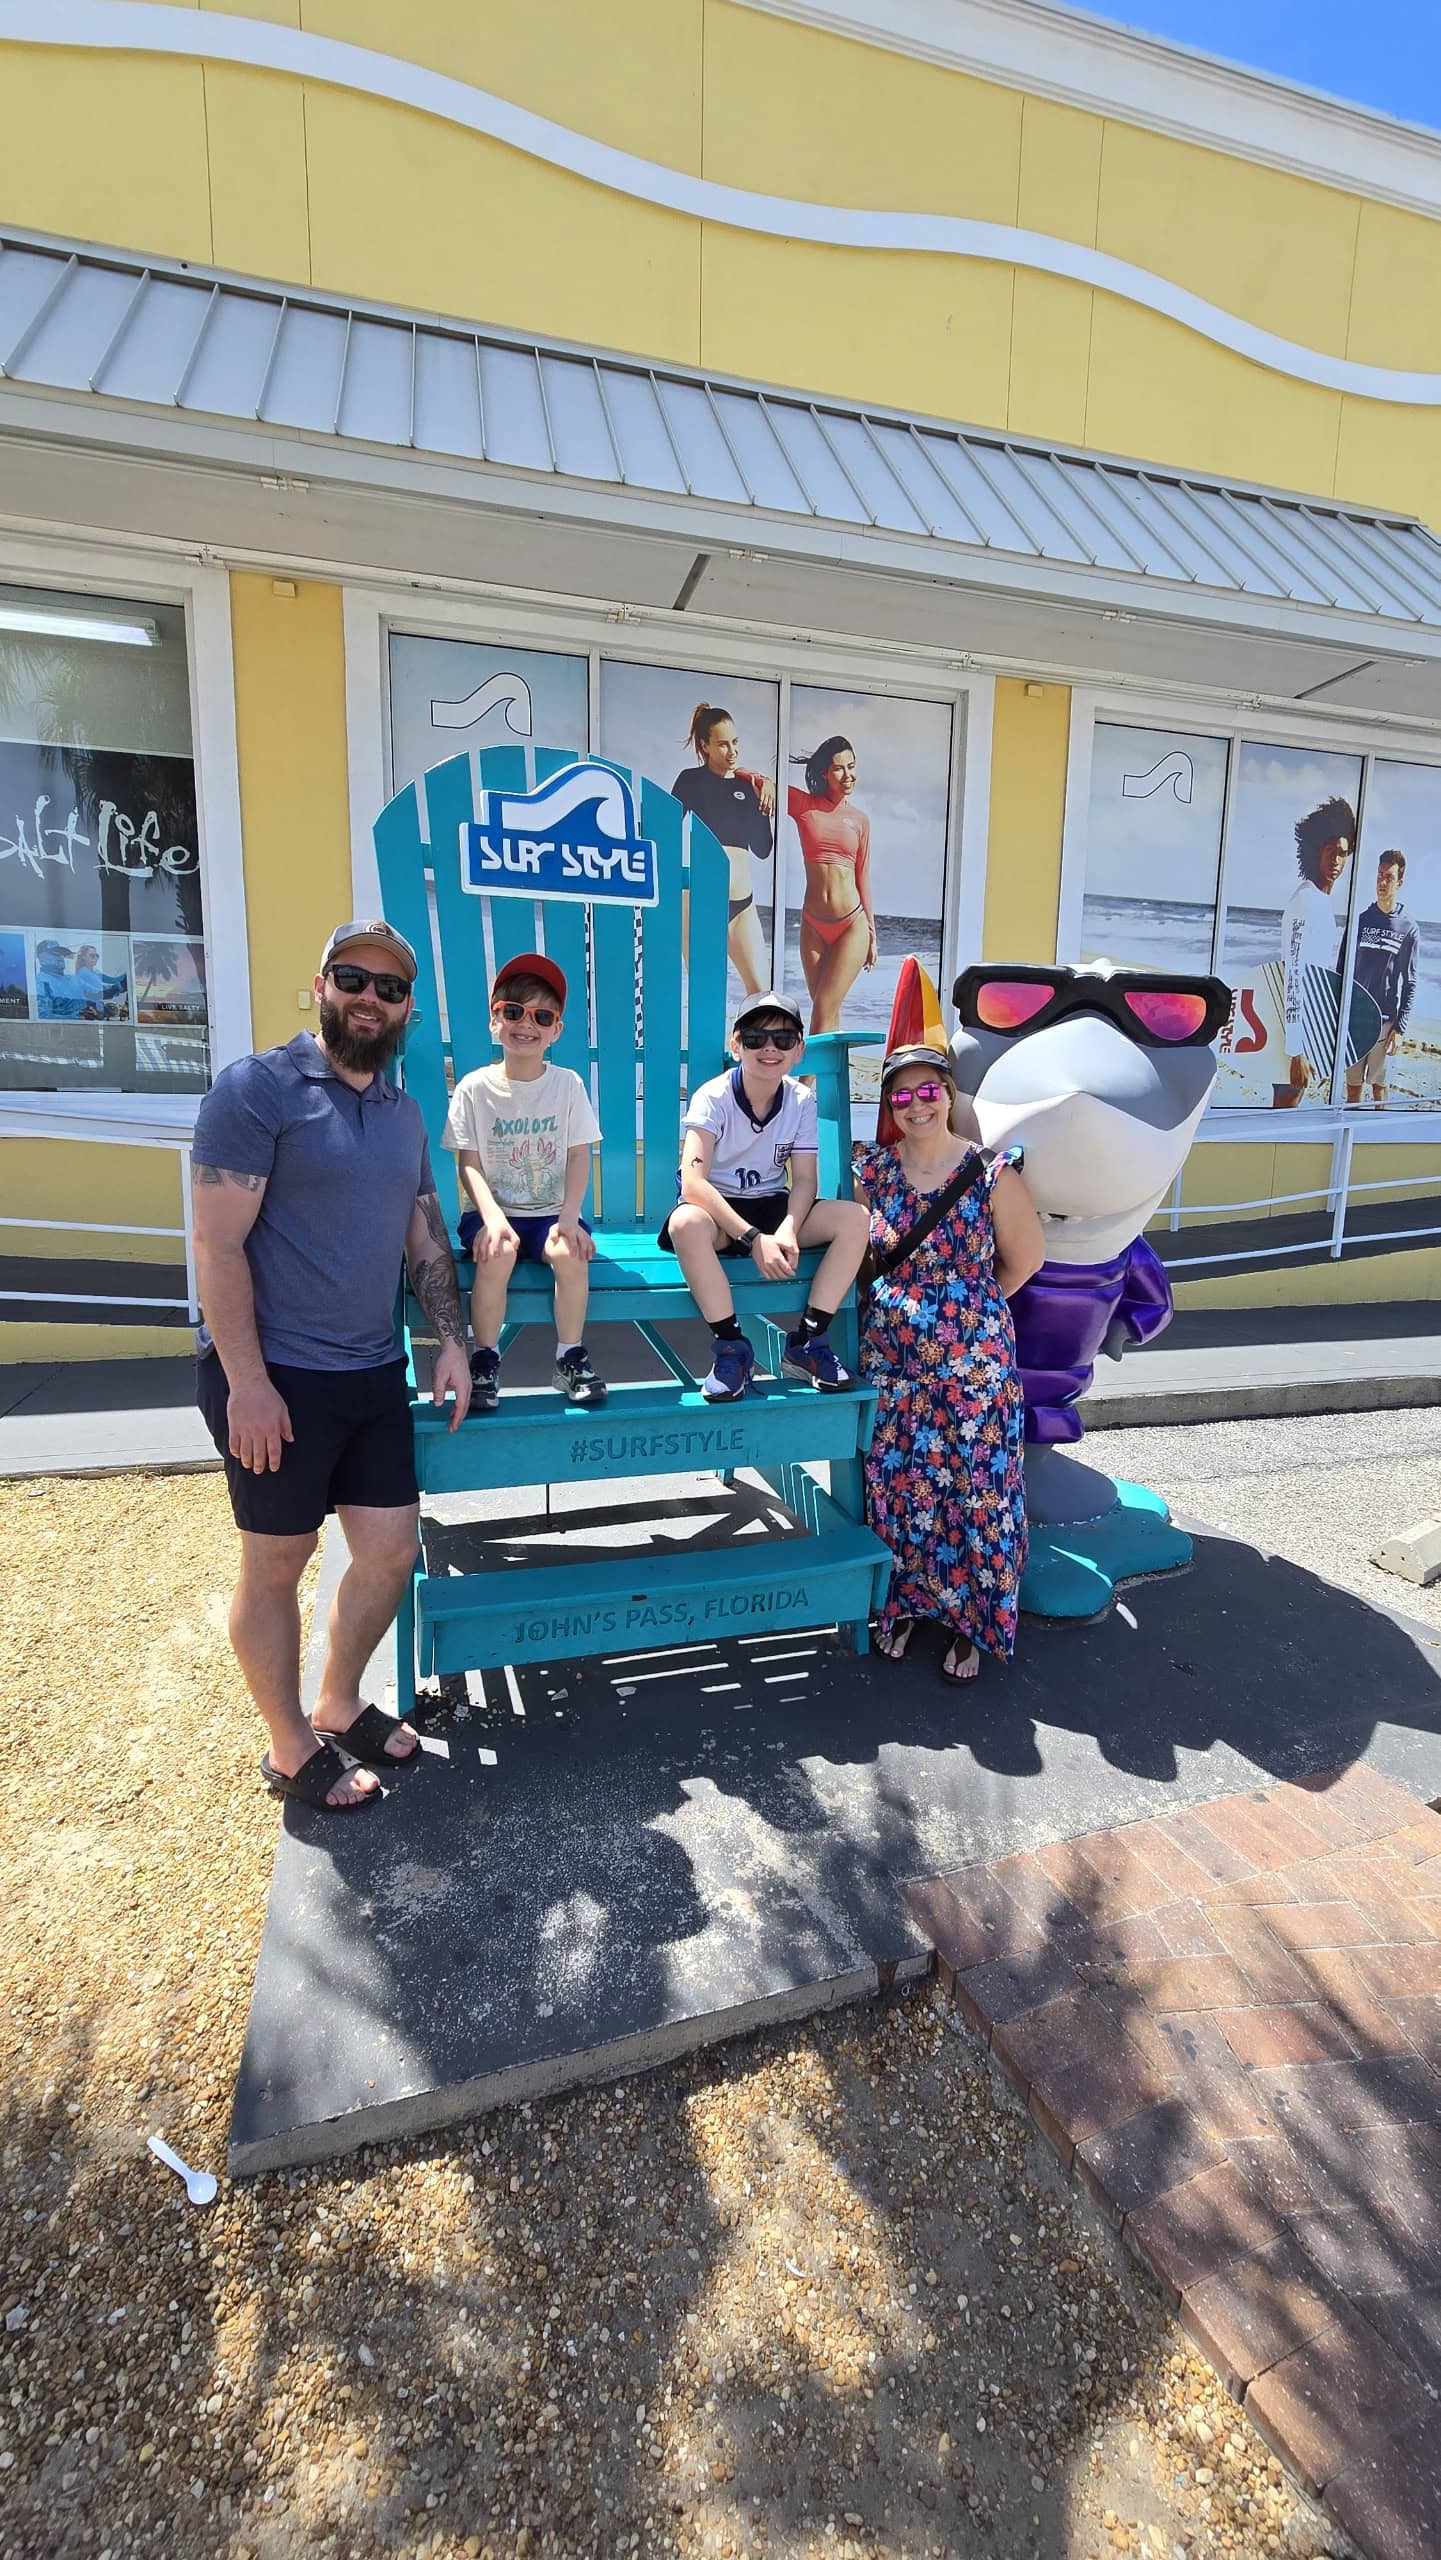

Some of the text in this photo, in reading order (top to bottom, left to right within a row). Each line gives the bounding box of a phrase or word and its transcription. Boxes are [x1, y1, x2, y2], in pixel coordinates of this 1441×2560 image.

[561, 843, 646, 882] STYLE
[1362, 927, 1405, 942] SURF STYLE
[492, 1115, 558, 1138] AXOLOTL
[735, 1168, 761, 1189] 10
[570, 1428, 745, 1463] #SURFSTYLE
[514, 1587, 809, 1643] JOHN'S PASS, FLORIDA
